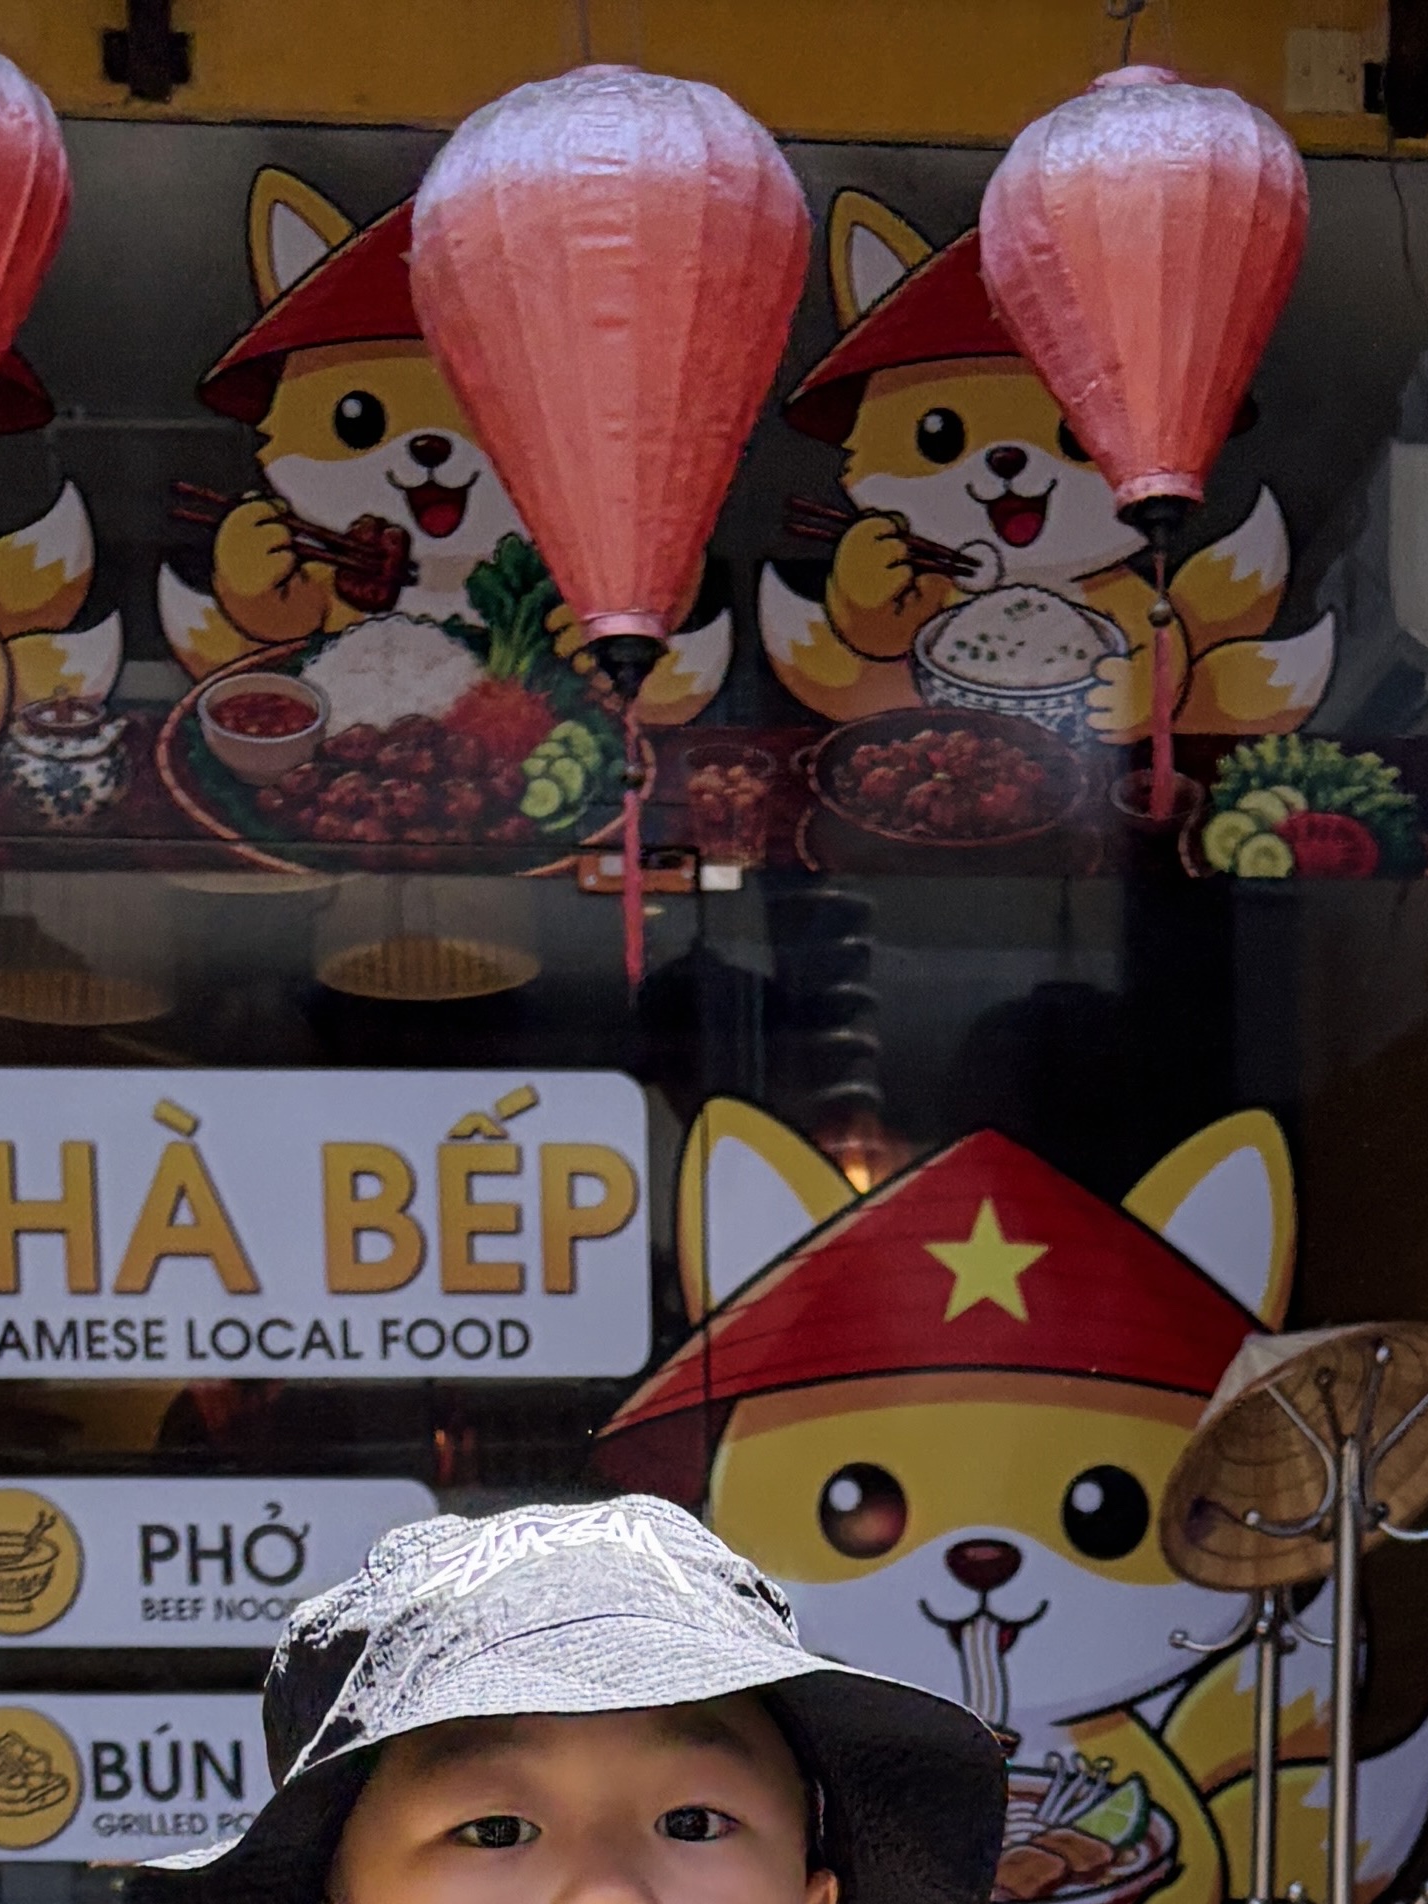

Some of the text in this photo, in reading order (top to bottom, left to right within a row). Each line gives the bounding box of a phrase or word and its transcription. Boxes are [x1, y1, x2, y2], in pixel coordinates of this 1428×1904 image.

[320, 1084, 639, 1297] BẾP
[185, 1315, 363, 1362] LOCAL
[379, 1316, 532, 1362] FOOD
[139, 1502, 311, 1587] PHỞ
[140, 1597, 205, 1622] BEEF
[91, 1722, 245, 1802] BÚN
[92, 1811, 209, 1838] GRILLED
